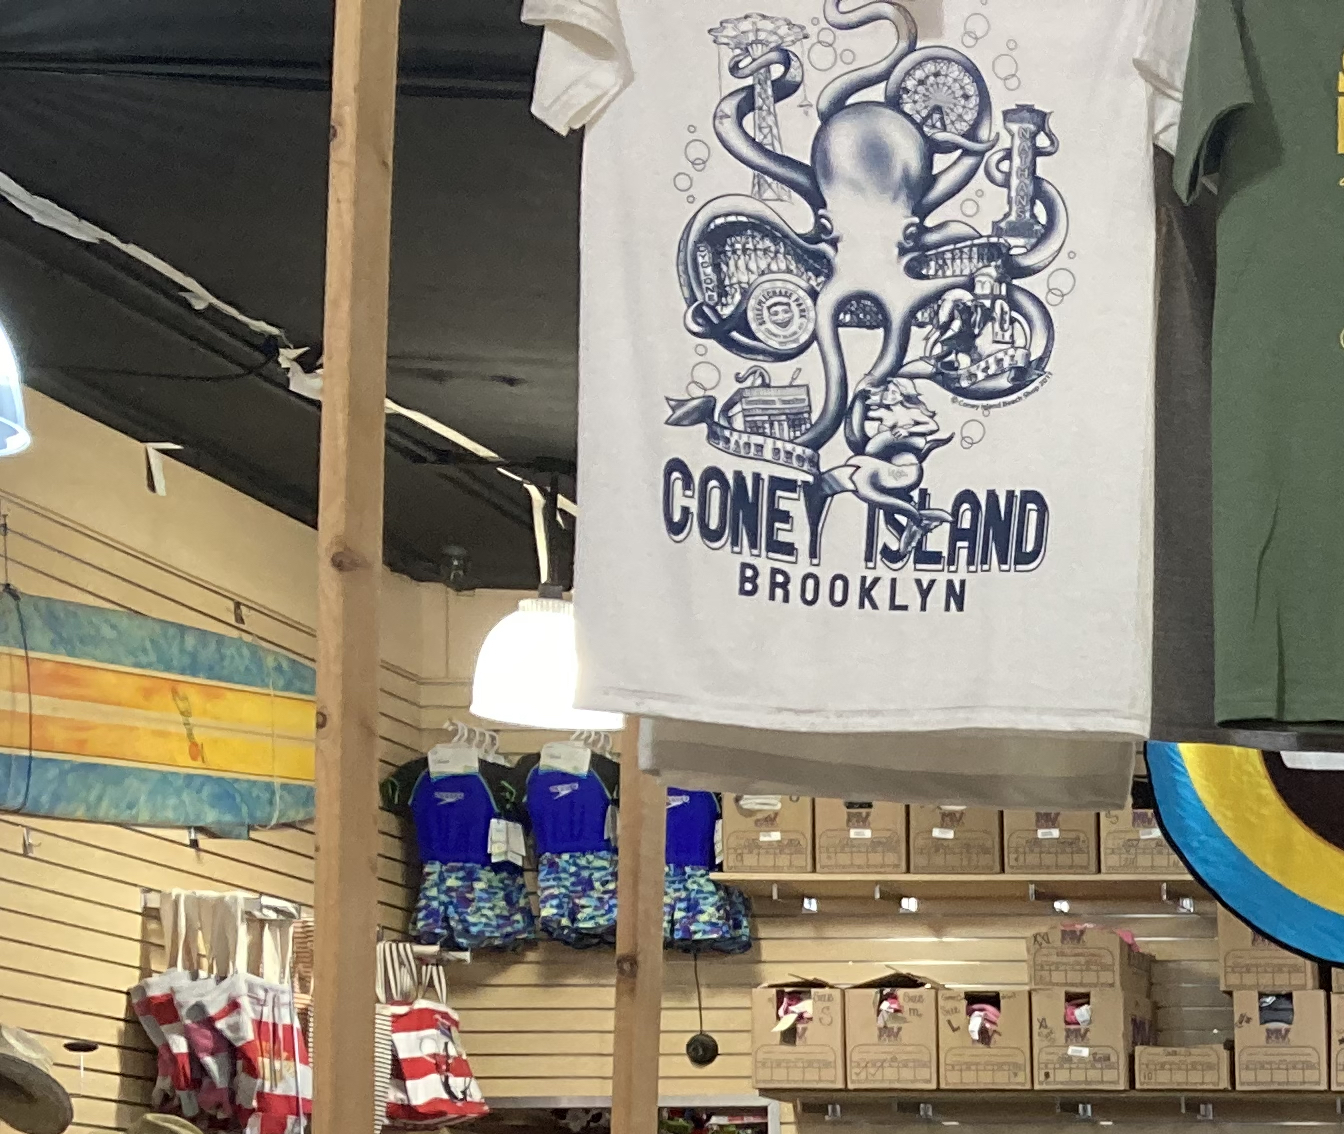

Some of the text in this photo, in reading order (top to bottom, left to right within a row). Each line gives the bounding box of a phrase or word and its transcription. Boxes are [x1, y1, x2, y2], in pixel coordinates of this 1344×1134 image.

[663, 457, 1048, 573] CONEY ISLAND
[738, 562, 967, 612] BROOKLYN
